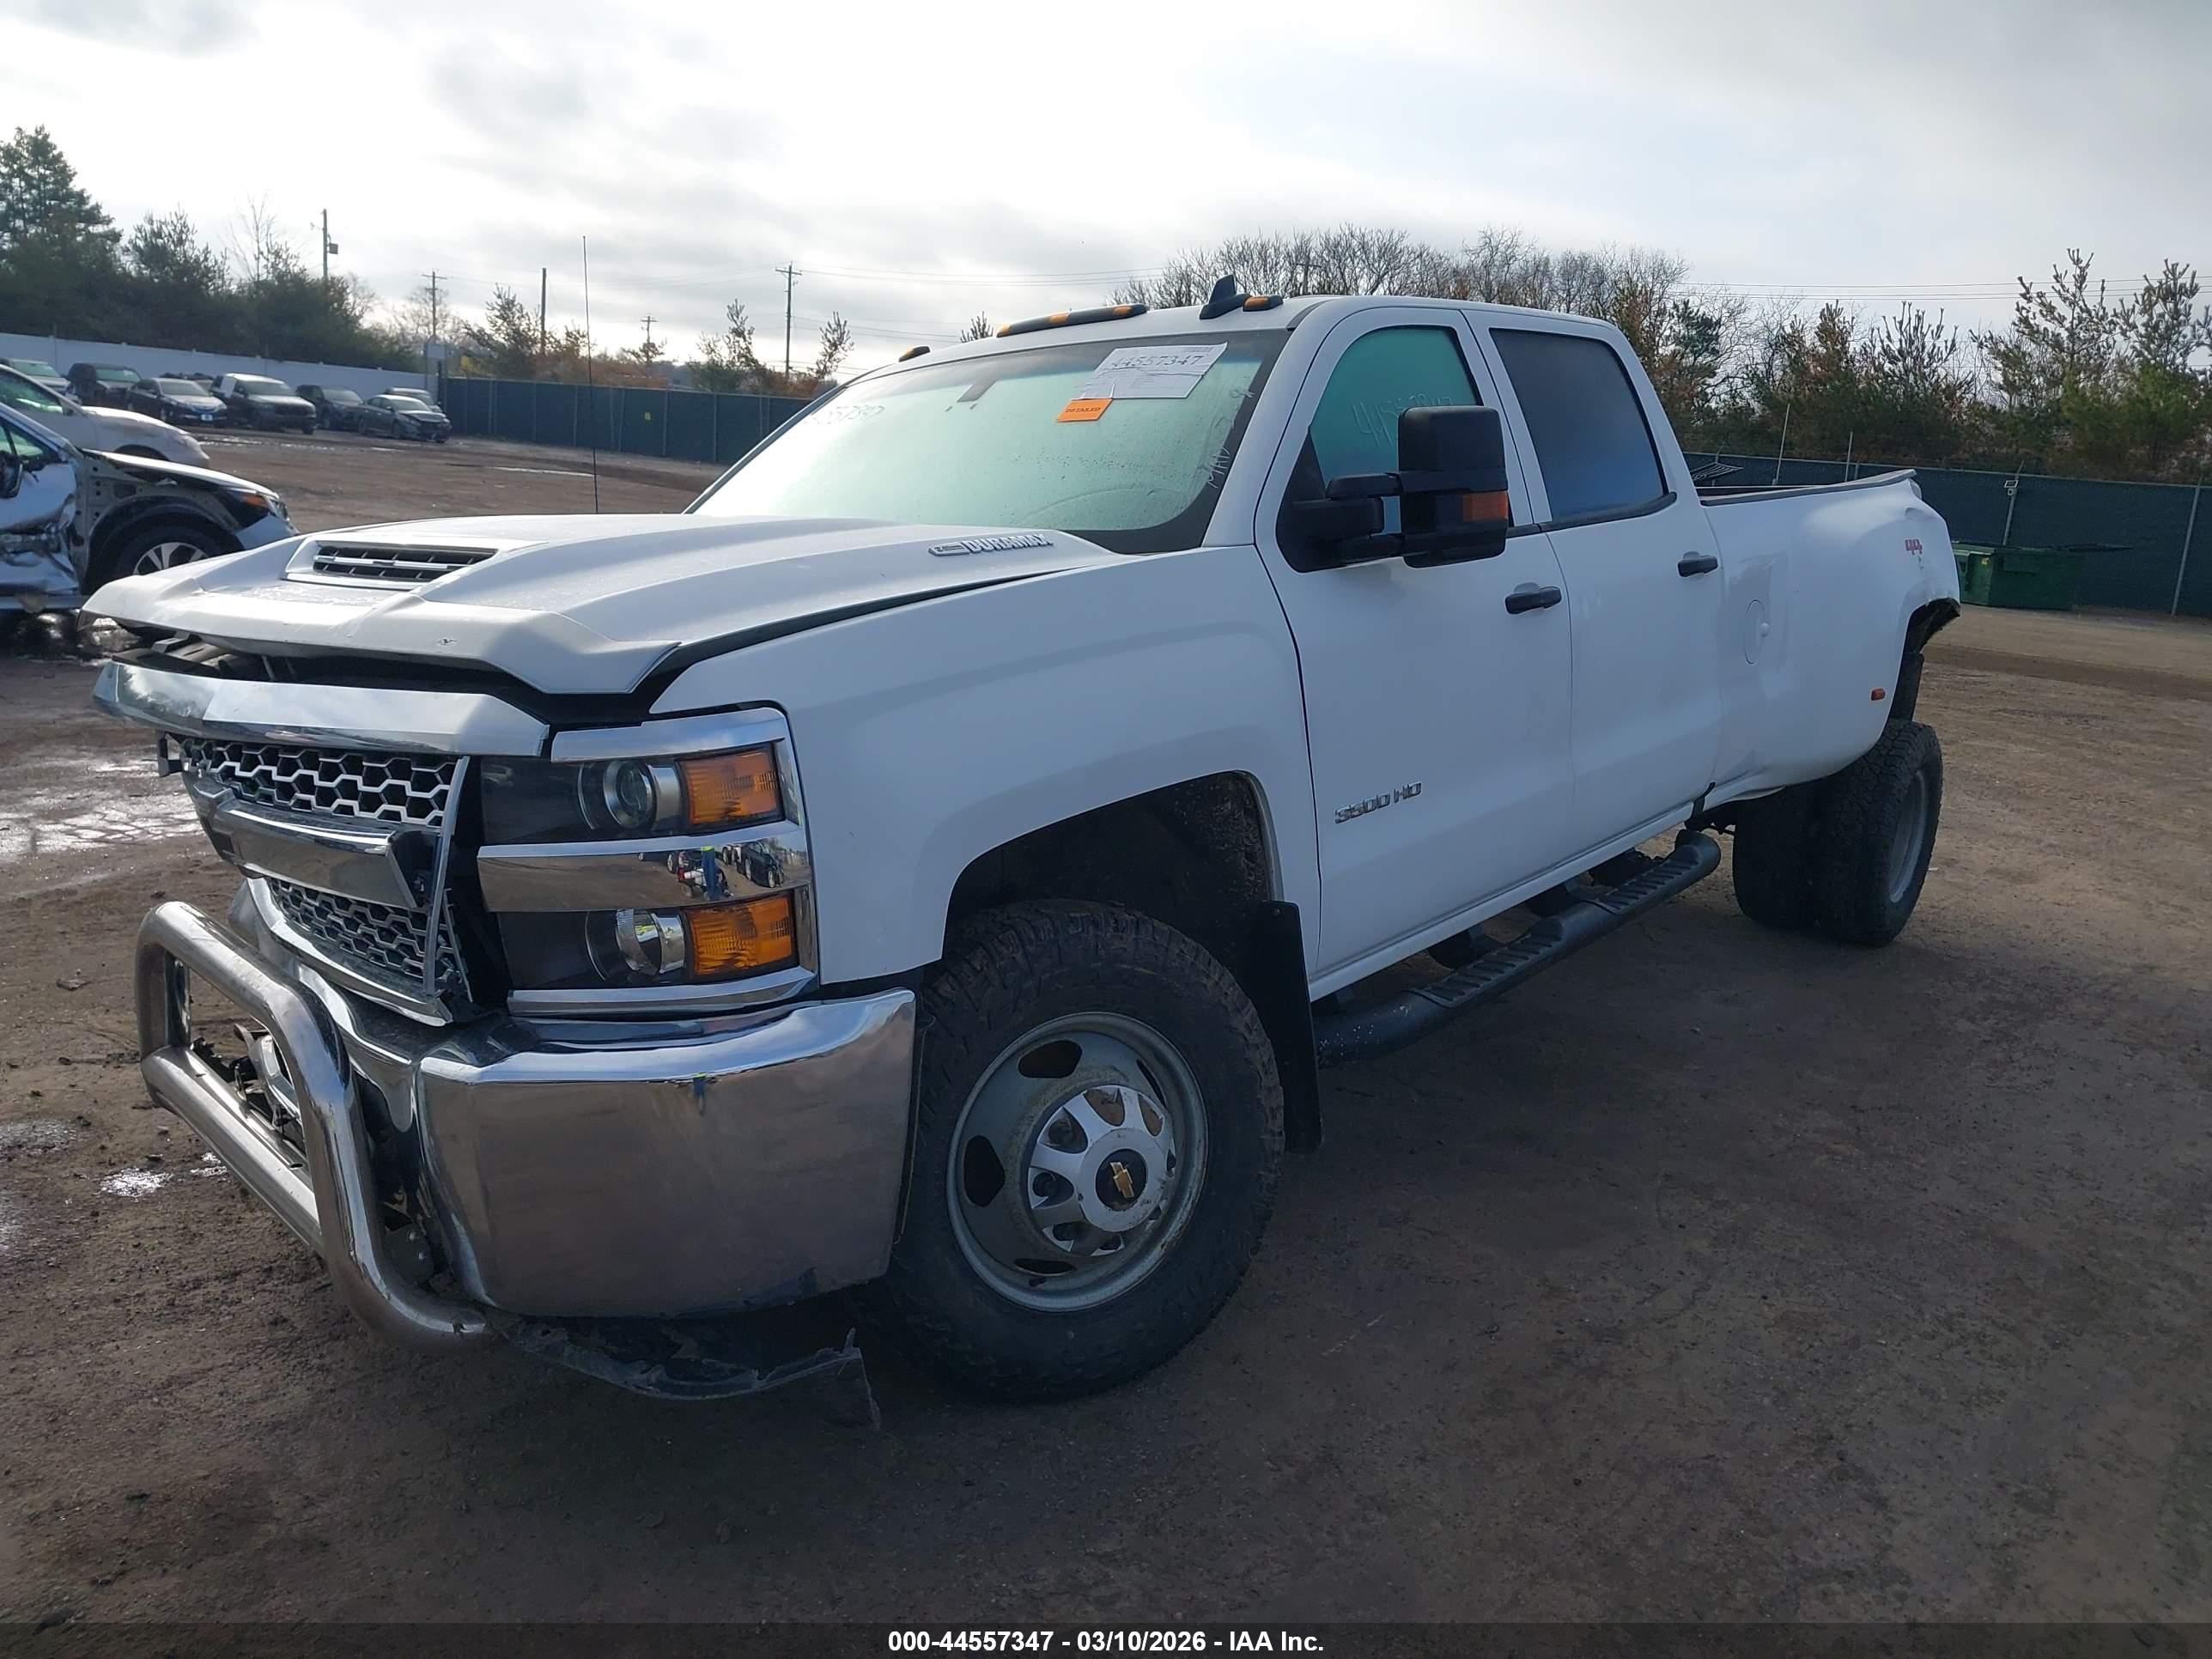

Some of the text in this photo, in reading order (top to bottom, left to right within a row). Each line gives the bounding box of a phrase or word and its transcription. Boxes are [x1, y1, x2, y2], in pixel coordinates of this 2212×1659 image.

[961, 532, 1054, 555] DURAMAX
[1334, 781, 1422, 824] 3500 HD
